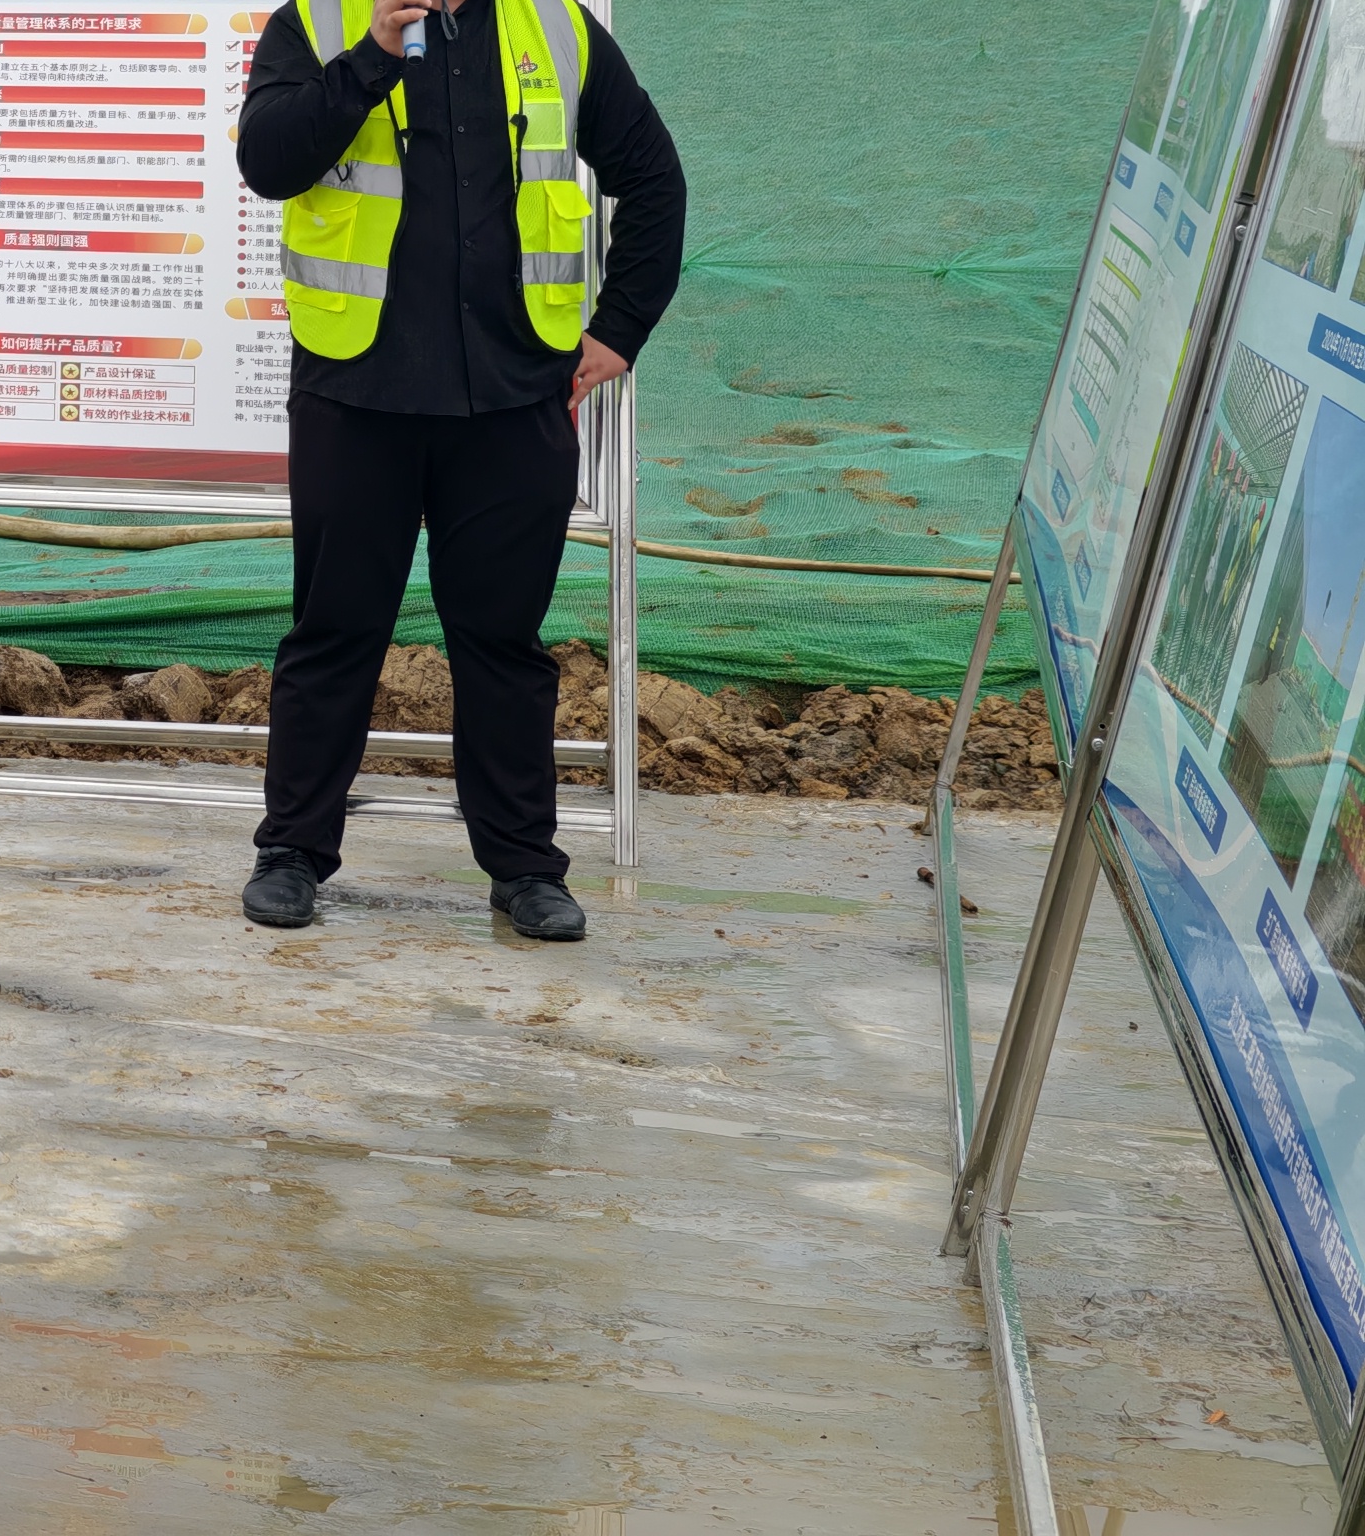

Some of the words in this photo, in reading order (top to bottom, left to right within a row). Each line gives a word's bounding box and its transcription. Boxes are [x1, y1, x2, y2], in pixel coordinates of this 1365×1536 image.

[4, 234, 89, 248] 质量强则国强
[1, 337, 122, 354] 如何提升产品质量?
[84, 367, 156, 380] 产品设计保证
[83, 388, 167, 401] 原材料品质控制
[83, 408, 191, 422] 有效的作业技术标准
